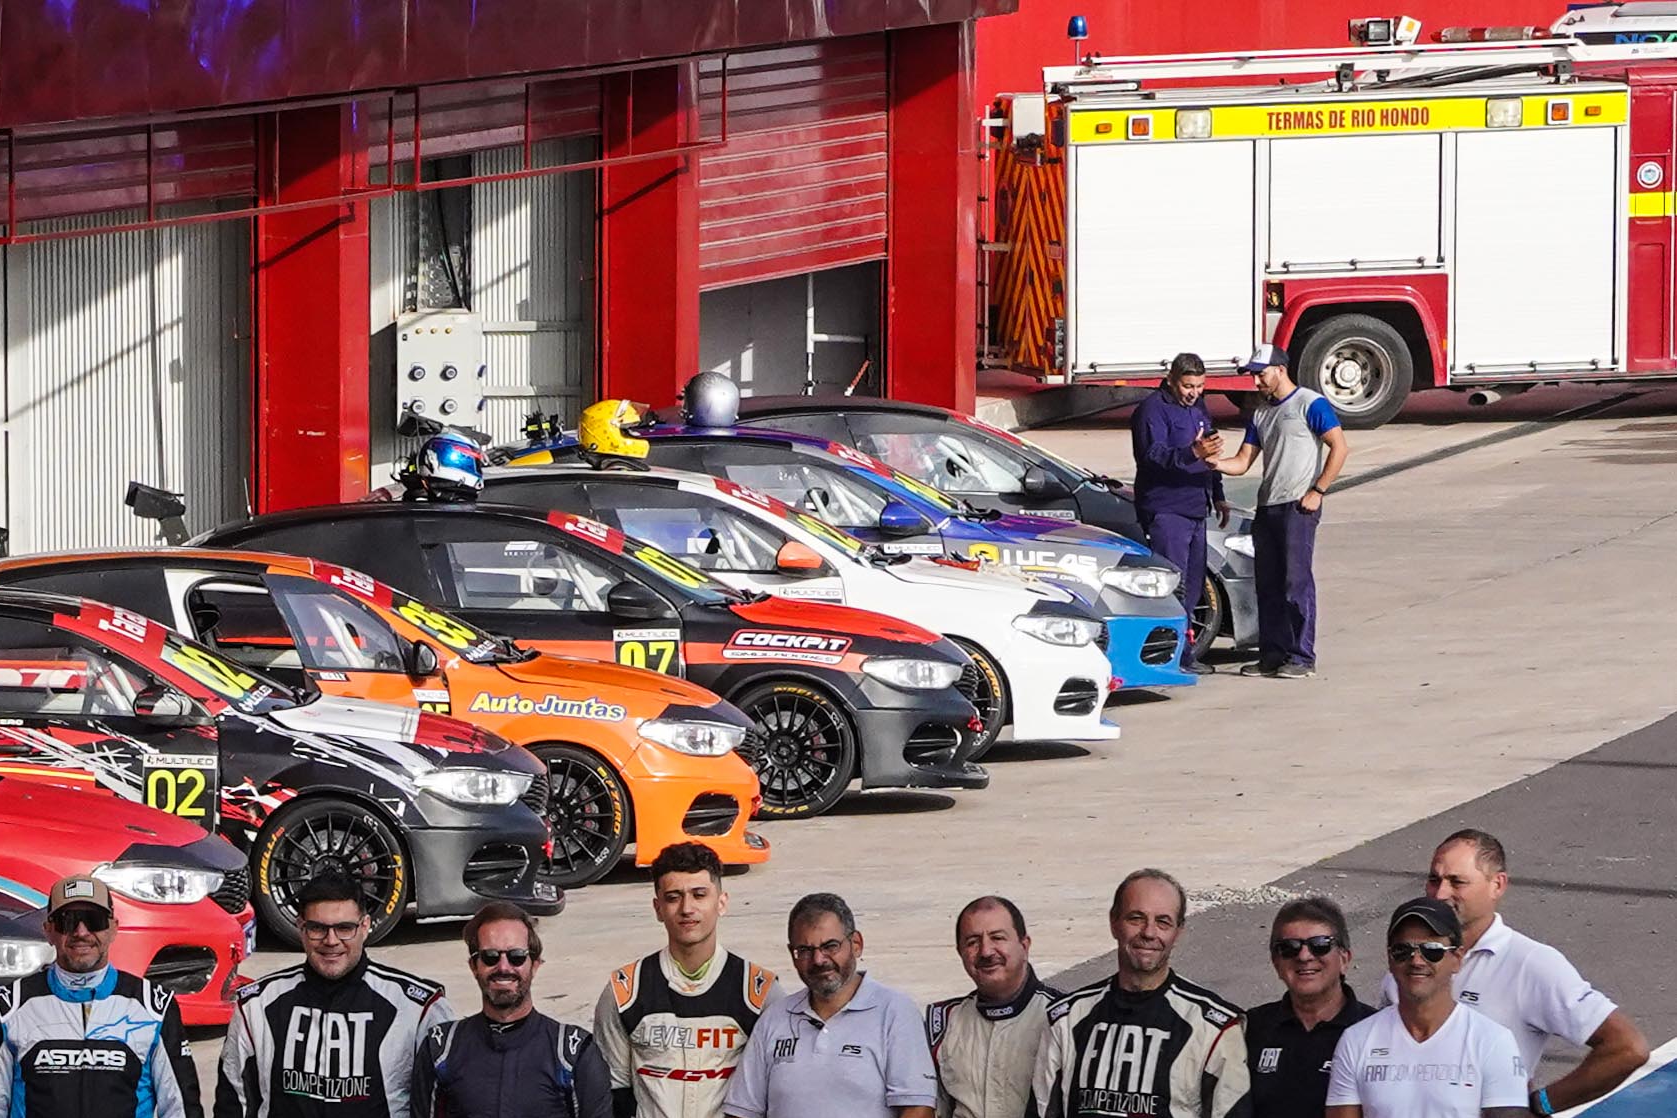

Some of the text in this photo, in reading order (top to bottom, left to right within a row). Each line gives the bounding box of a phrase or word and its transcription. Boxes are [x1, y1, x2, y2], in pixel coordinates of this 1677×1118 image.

[1267, 106, 1430, 131] TERMAS DE RIO HONDO
[619, 640, 675, 674] 07
[470, 691, 537, 715] Auto
[536, 693, 626, 721] Juntas
[156, 757, 214, 766] MULTILED
[147, 769, 206, 817] 02
[1459, 991, 1480, 1002] FS
[283, 1005, 374, 1078] FIAT
[773, 1037, 799, 1058] FIAT
[841, 1044, 861, 1055] FS
[1370, 1048, 1390, 1056] FS
[33, 1048, 127, 1067] ASTARS
[1078, 1022, 1172, 1094] FIAT
[1258, 1047, 1283, 1069] FIAT
[282, 1068, 372, 1098] COMPETIZIONE
